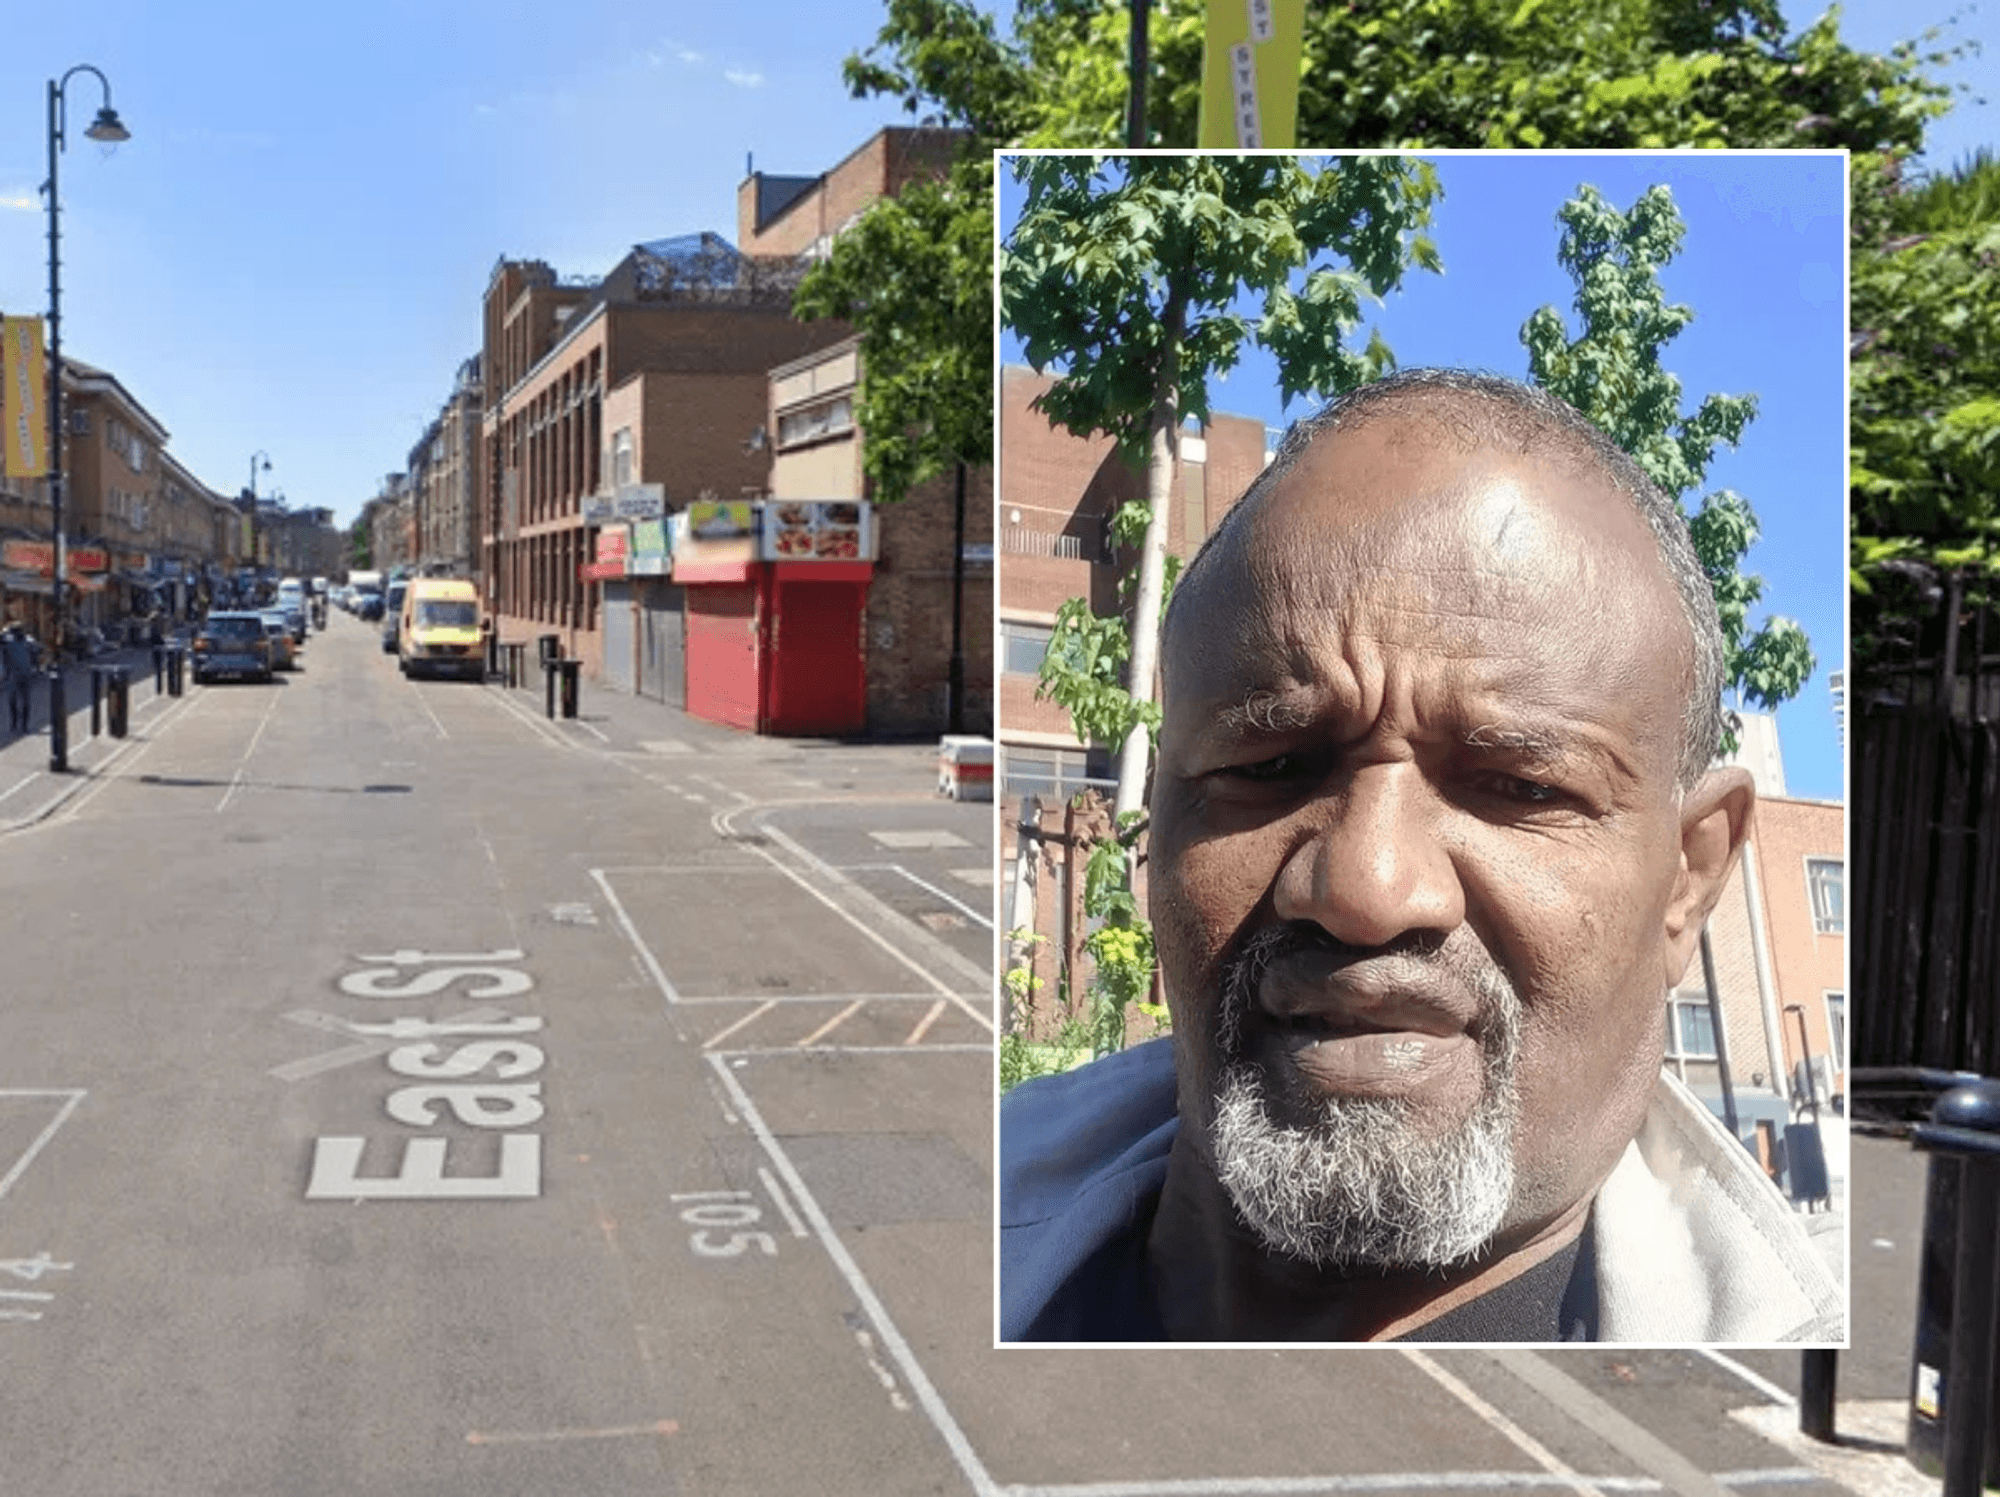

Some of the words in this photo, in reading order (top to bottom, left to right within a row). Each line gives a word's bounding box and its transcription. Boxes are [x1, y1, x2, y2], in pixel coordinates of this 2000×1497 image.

[339, 948, 533, 998] St
[305, 1015, 544, 1199] East
[670, 1191, 779, 1256] 105
